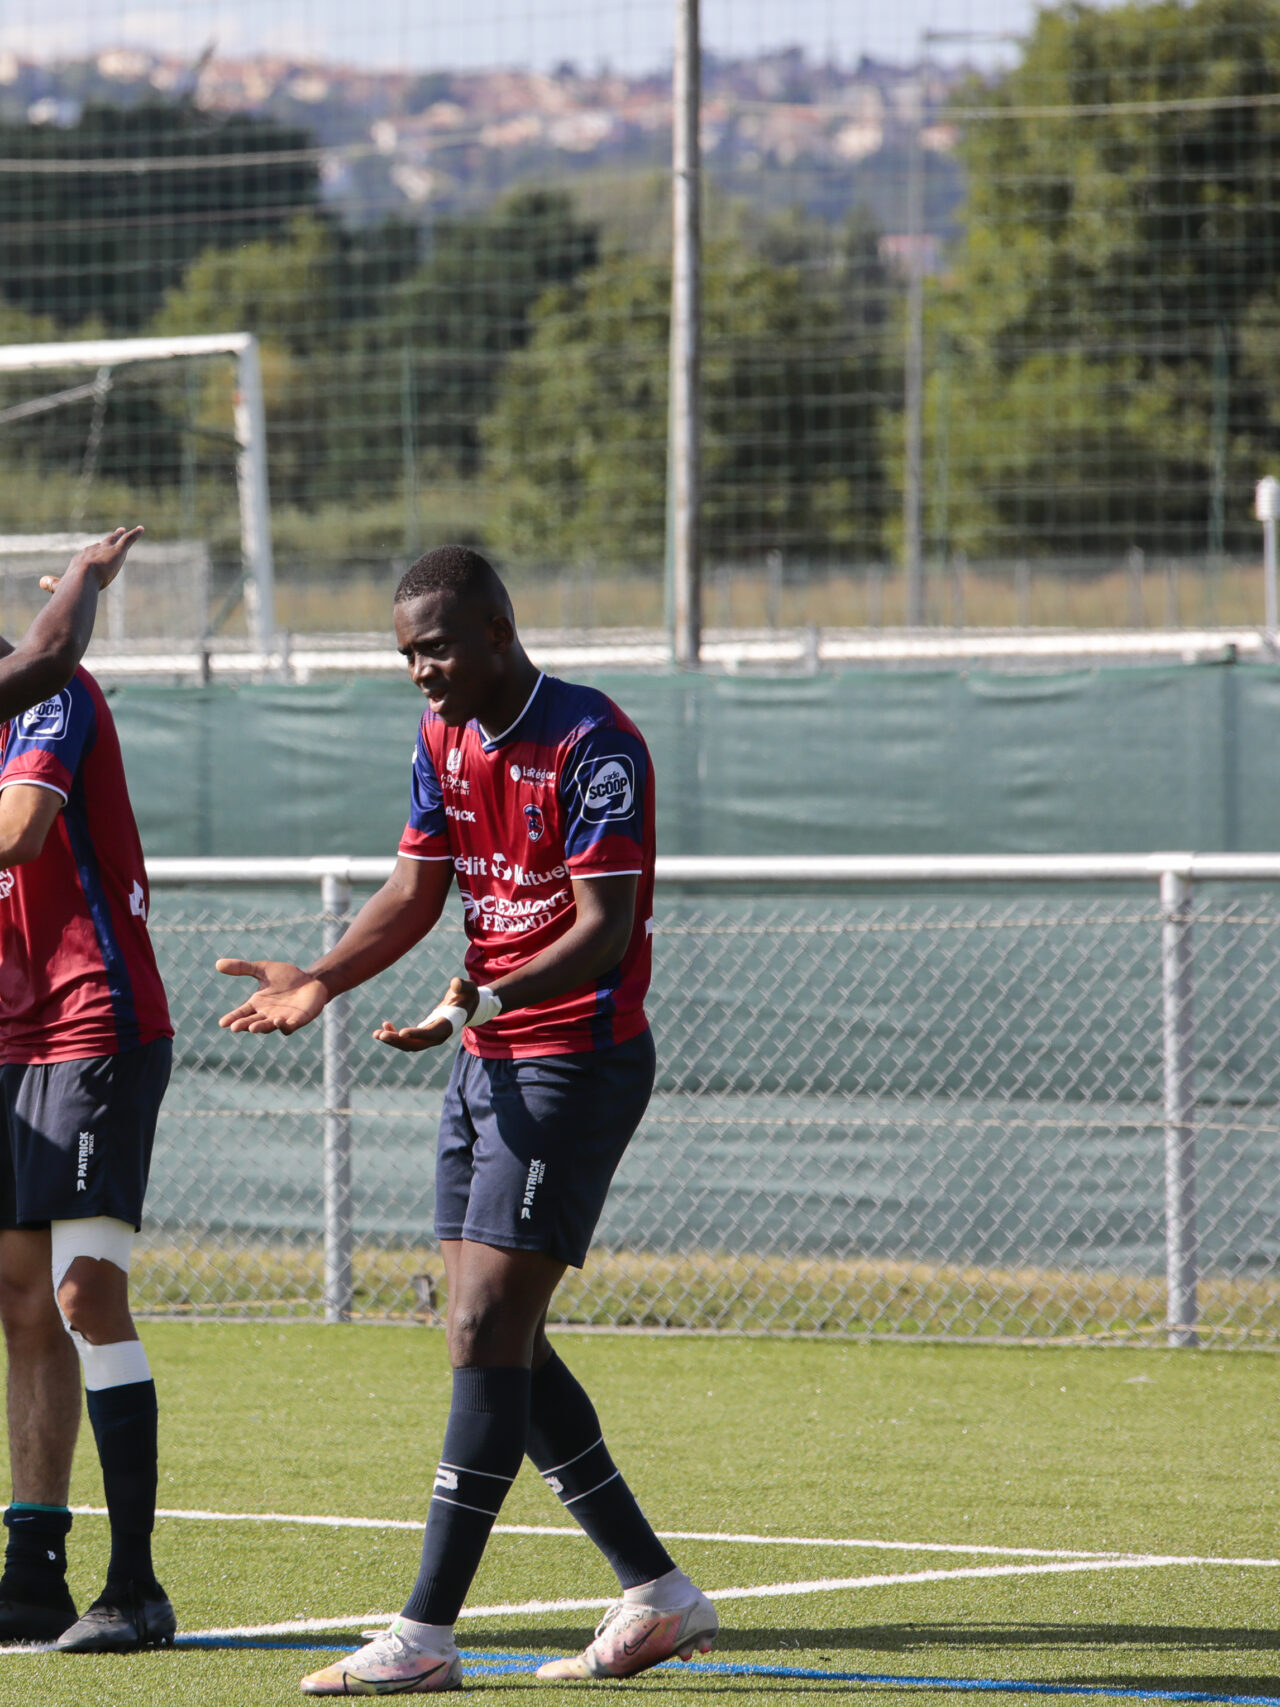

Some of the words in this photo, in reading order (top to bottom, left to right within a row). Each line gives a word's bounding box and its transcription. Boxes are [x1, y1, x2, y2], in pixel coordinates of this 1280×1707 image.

[588, 777, 628, 800] SCOOP
[603, 770, 620, 781] radio
[77, 1131, 89, 1177] PATRICK
[523, 1158, 541, 1206] PATRICK
